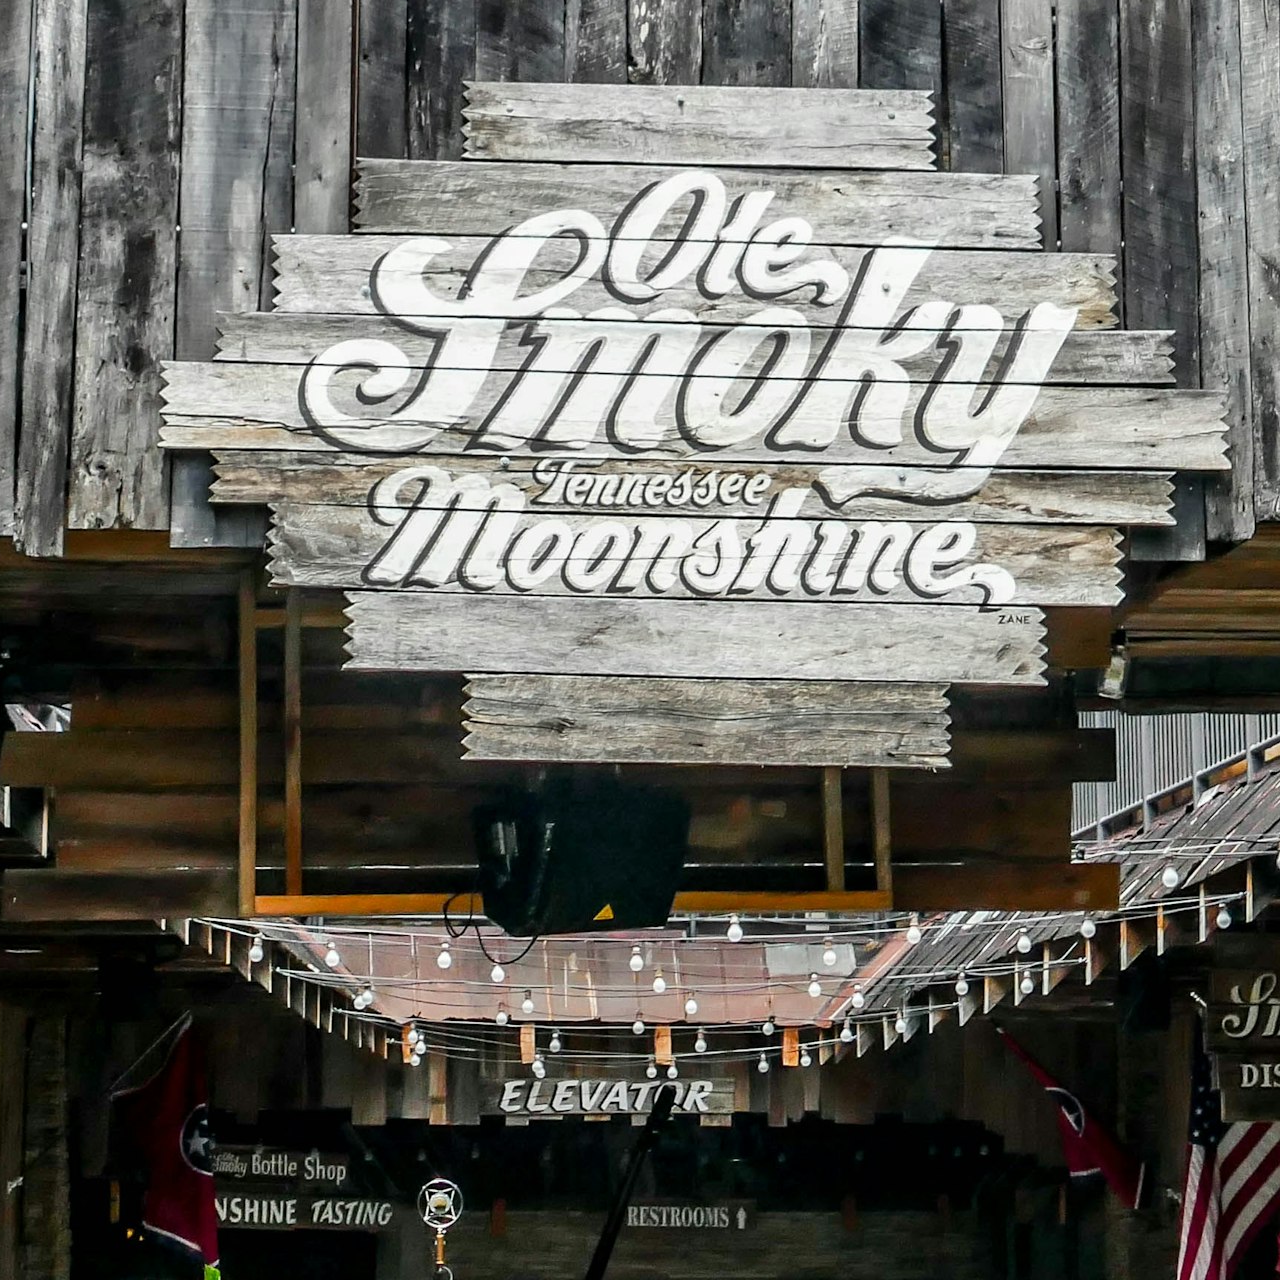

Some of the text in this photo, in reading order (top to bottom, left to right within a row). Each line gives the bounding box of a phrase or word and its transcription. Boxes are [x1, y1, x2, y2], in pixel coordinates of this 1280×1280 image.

[604, 169, 848, 307] Ole
[300, 209, 1079, 506] Smoky
[532, 457, 772, 511] Tennessee
[362, 465, 1017, 613] Moonshine
[998, 615, 1031, 625] ZANE
[252, 1154, 297, 1177] Bottle
[304, 1156, 347, 1186] Shop
[214, 1197, 393, 1226] NSHINE TASTING
[627, 1206, 730, 1228] RESTROOMS
